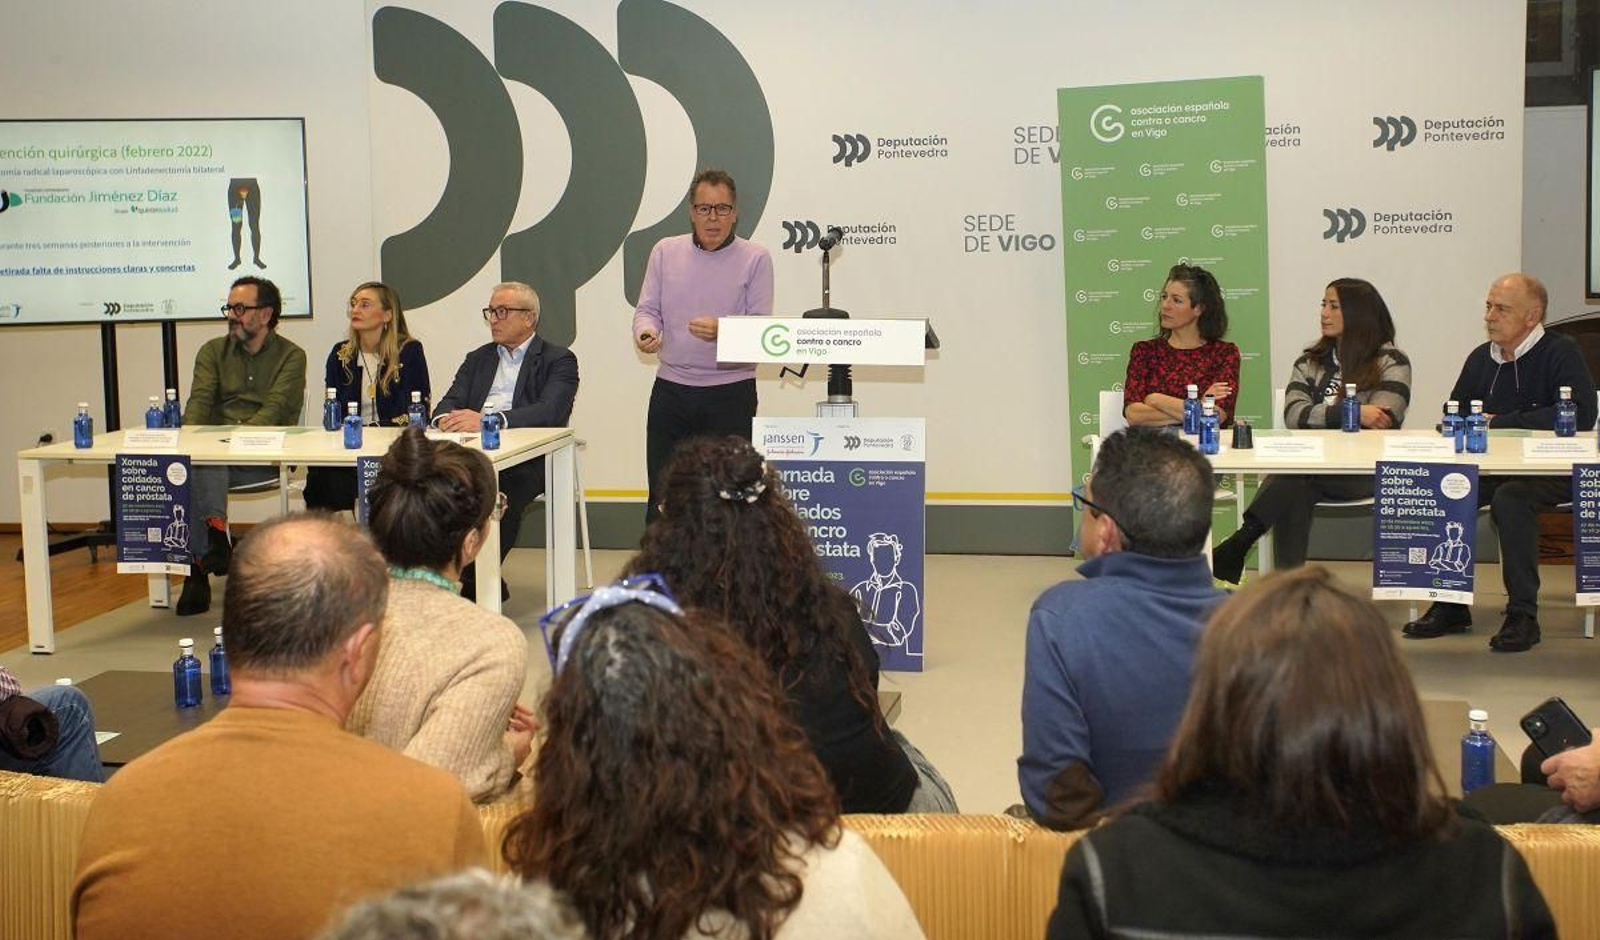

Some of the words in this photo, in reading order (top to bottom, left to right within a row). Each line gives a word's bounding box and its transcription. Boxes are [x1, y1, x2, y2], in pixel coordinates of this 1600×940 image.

[1130, 103, 1182, 115] asociación
[1184, 101, 1229, 114] española
[1131, 117, 1162, 126] contra
[1172, 115, 1206, 124] cancro
[1424, 115, 1505, 132] Deputación
[1131, 130, 1144, 138] en
[1145, 129, 1168, 139] Vigo
[1265, 123, 1301, 135] ación
[877, 134, 948, 149] Deputación
[1424, 130, 1505, 143] Pontevedra
[48, 145, 117, 160] quirúrgica
[121, 144, 174, 159] (febrero
[177, 144, 213, 158] 2022)
[877, 148, 948, 159] Pontevedra
[1015, 147, 1041, 165] DE
[24, 193, 86, 204] Fundación
[88, 190, 144, 203] Jiménez
[147, 189, 178, 202] Díaz
[1373, 208, 1453, 225] Deputación
[827, 222, 897, 234] Dputación
[963, 214, 1016, 232] SEDE
[1373, 223, 1453, 235] Pontevedra
[964, 235, 991, 253] DE
[997, 233, 1056, 252] VIGO
[32, 266, 51, 275] falta
[53, 266, 64, 274] de
[65, 265, 121, 274] instrucciones
[123, 265, 147, 273] claras
[155, 264, 196, 273] concretas
[797, 327, 842, 336] asociación
[843, 328, 882, 338] española
[796, 338, 824, 346] contra
[808, 347, 828, 357] Vigo
[121, 458, 158, 467] Xornada
[121, 466, 147, 475] sobre
[1381, 466, 1430, 476] Xornada
[121, 474, 162, 484] coidados
[1381, 476, 1413, 486] sobre
[121, 484, 134, 492] en
[135, 485, 166, 493] cancro
[1381, 486, 1434, 497] coidados
[121, 492, 135, 501] de
[136, 492, 173, 503] próstata
[1380, 497, 1395, 505] en
[1396, 498, 1437, 507] cancro
[1580, 500, 1596, 509] en
[1380, 506, 1395, 515] de
[1396, 507, 1446, 518] próstata
[1580, 508, 1596, 518] de
